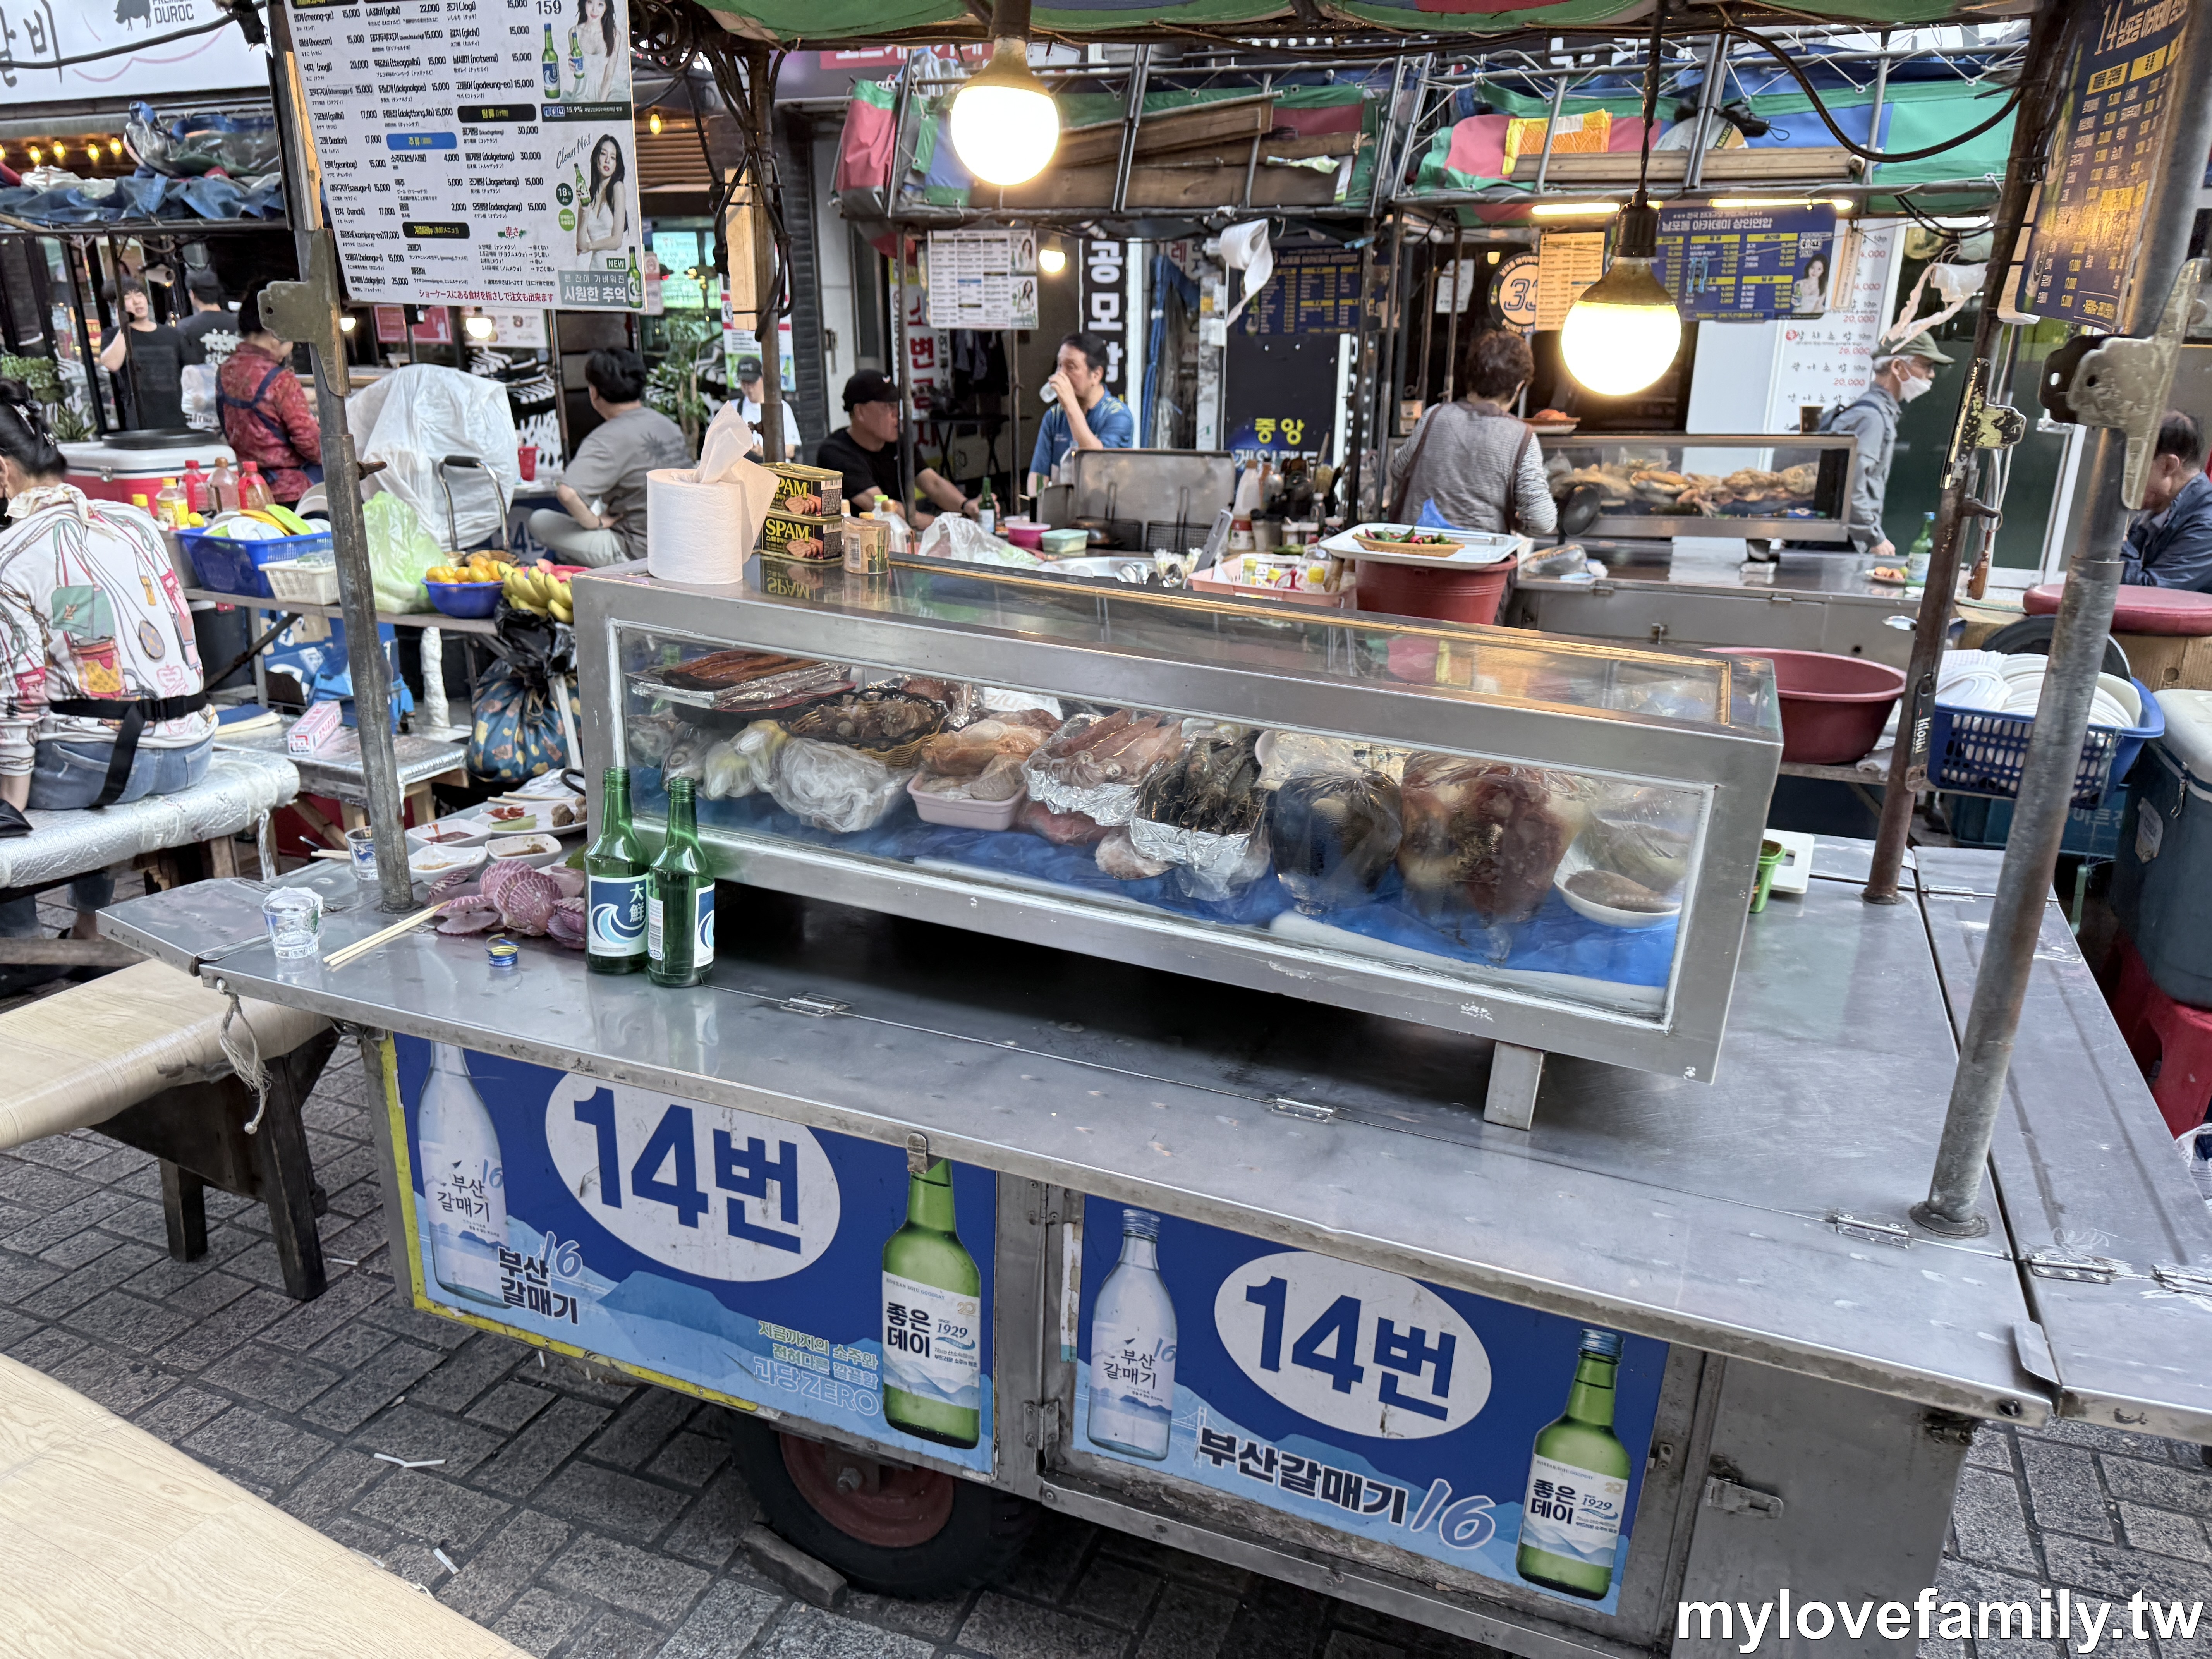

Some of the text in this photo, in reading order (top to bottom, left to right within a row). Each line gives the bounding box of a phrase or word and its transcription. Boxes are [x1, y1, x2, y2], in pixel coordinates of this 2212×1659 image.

[155, 3, 194, 24] DUROC
[342, 9, 360, 18] 15,000
[419, 3, 440, 13] 22,000
[424, 30, 443, 40] 15,000
[509, 26, 529, 37] 15,000
[347, 34, 365, 45] 15,000
[428, 56, 446, 66] 15,000
[512, 52, 532, 63] 15,000
[350, 60, 369, 70] 20,000
[356, 84, 373, 94] 15,000
[431, 82, 450, 92] 15,000
[514, 79, 534, 89] 15,000
[360, 110, 377, 120] 17,000
[435, 108, 453, 117] 15,000
[517, 126, 538, 136] 30,000
[365, 134, 382, 144] 17,000
[444, 153, 459, 162] 4,000
[520, 151, 541, 161] 30,000
[556, 147, 576, 169] Clean
[369, 159, 386, 169] 15,000
[448, 178, 463, 187] 5,000
[525, 177, 544, 187] 15,000
[374, 183, 391, 193] 15,000
[378, 207, 395, 217] 17,000
[451, 203, 467, 212] 2,000
[528, 203, 547, 212] 15,000
[388, 254, 404, 263] 15,000
[608, 259, 625, 268] NEW
[391, 276, 409, 286] 25,000
[564, 286, 627, 303] 시원한 추억
[1087, 240, 1124, 383] 공모
[1254, 418, 1305, 445] 중앙
[776, 477, 808, 500] PAM
[765, 518, 810, 544] SPAM
[629, 882, 645, 923] 大鮮
[573, 1086, 801, 1255] 14번
[452, 1174, 485, 1199] 부산
[437, 1191, 489, 1223] 갈매기
[541, 1230, 584, 1278] 16
[497, 1246, 549, 1287] 부산
[501, 1276, 580, 1326] 갈매기
[886, 1302, 931, 1334] 좋은
[937, 1323, 968, 1338] 1929
[758, 1319, 878, 1371] 지금까지의 소주와
[887, 1326, 930, 1358] 데이
[1245, 1276, 1456, 1422] 14번
[1120, 1348, 1156, 1370] 부산
[1103, 1361, 1156, 1390] 갈매기
[1198, 1427, 1496, 1550] 부산갈매기 16
[1533, 1479, 1576, 1506] 좋은
[1581, 1497, 1613, 1510] 1929
[1530, 1498, 1573, 1525] 데이
